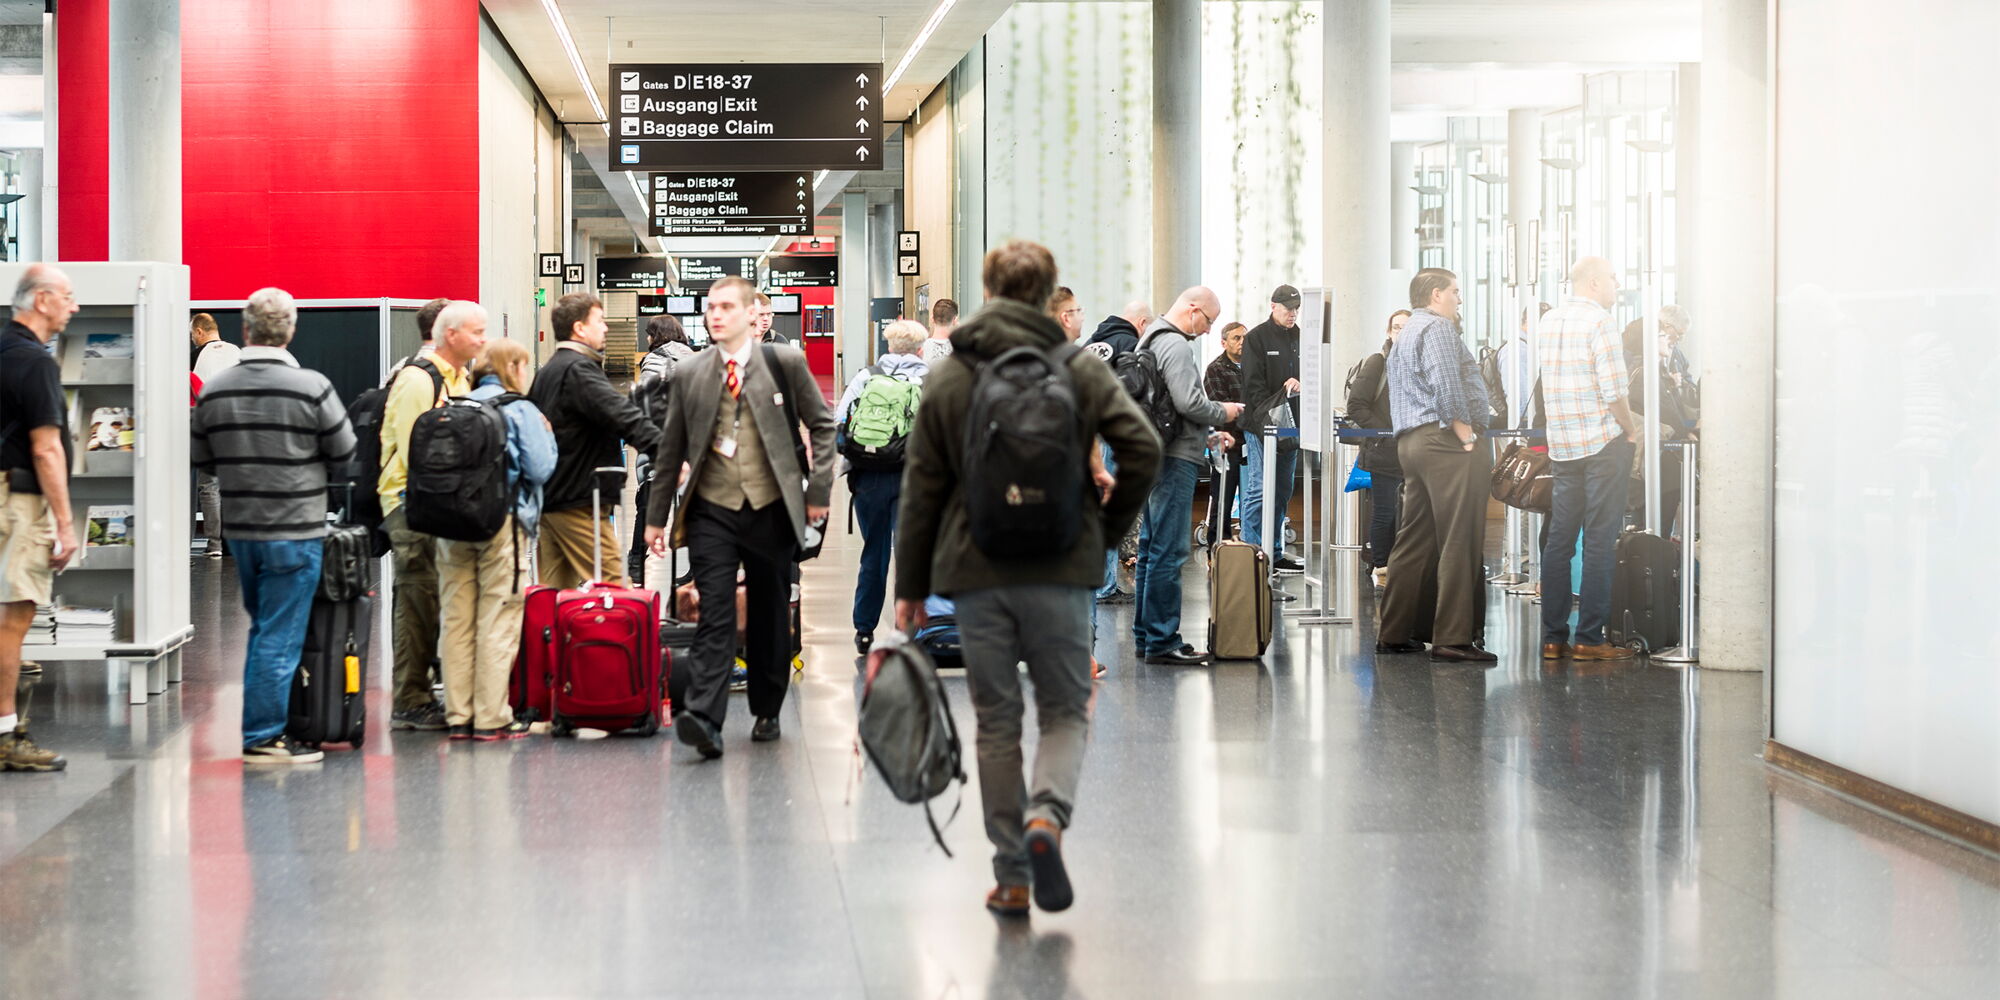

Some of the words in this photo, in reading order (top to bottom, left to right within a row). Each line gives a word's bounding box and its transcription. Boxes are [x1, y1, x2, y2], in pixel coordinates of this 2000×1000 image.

[643, 81, 669, 90] Gates
[643, 120, 719, 137] Baggage
[725, 119, 773, 135] Claim
[669, 205, 715, 216] Baggage
[718, 205, 748, 215] Claim
[745, 226, 765, 234] Lounge
